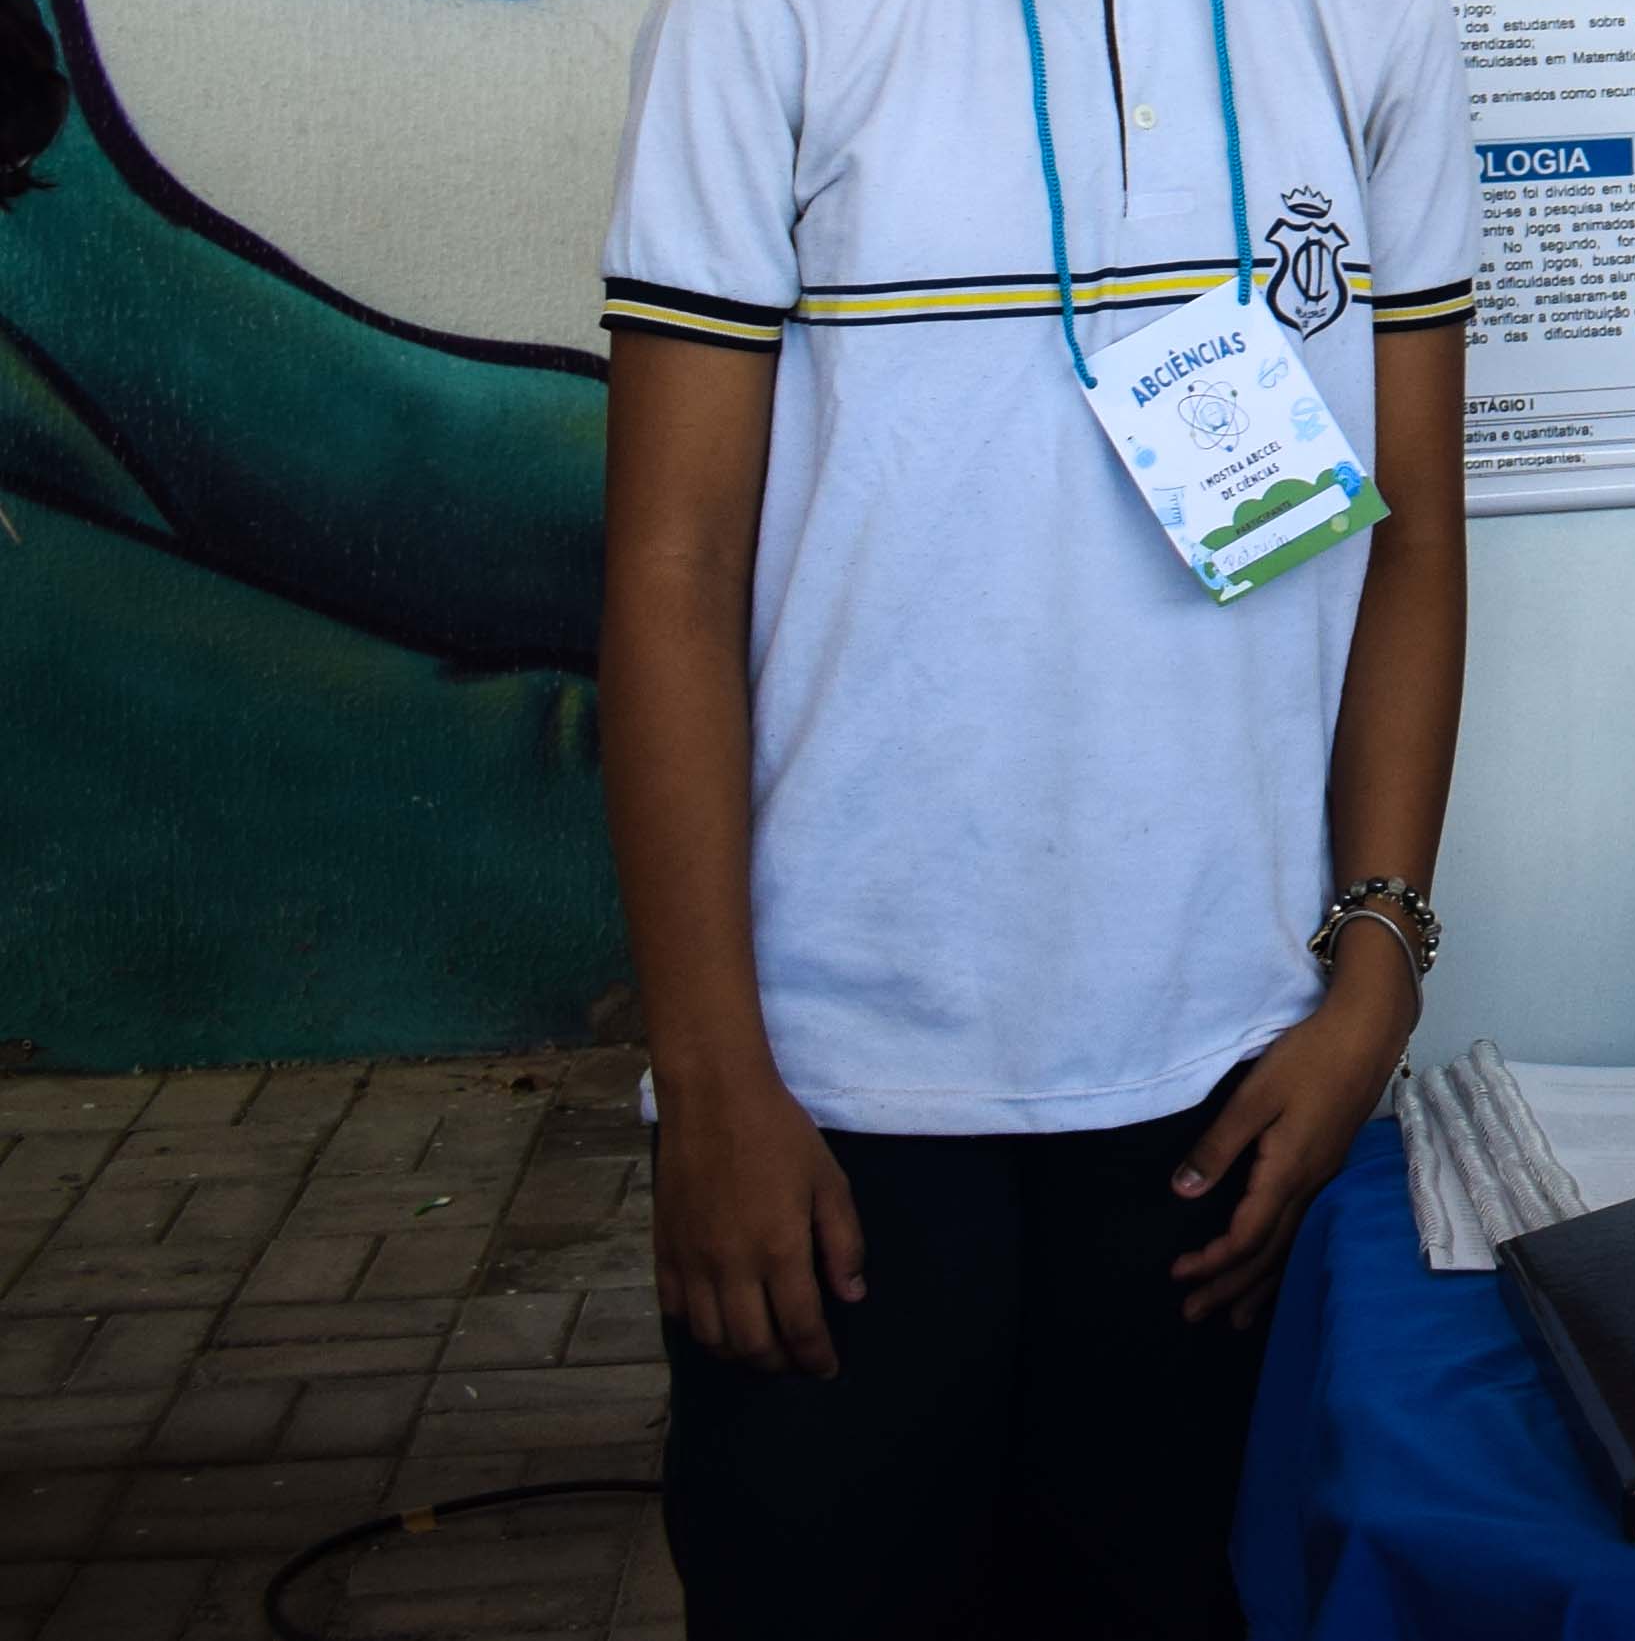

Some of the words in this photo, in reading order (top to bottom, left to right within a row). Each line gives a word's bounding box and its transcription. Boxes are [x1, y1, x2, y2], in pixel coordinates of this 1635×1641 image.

[1521, 184, 1538, 197] foi
[1545, 182, 1595, 197] dividido
[1601, 185, 1622, 194] em
[1130, 331, 1246, 408] ABCIÊNCIAS
[1206, 461, 1245, 488] MOSTRA
[1245, 441, 1283, 466] ABCCEL
[1221, 488, 1238, 501] DE
[1238, 463, 1280, 493] CIÊNCIAS
